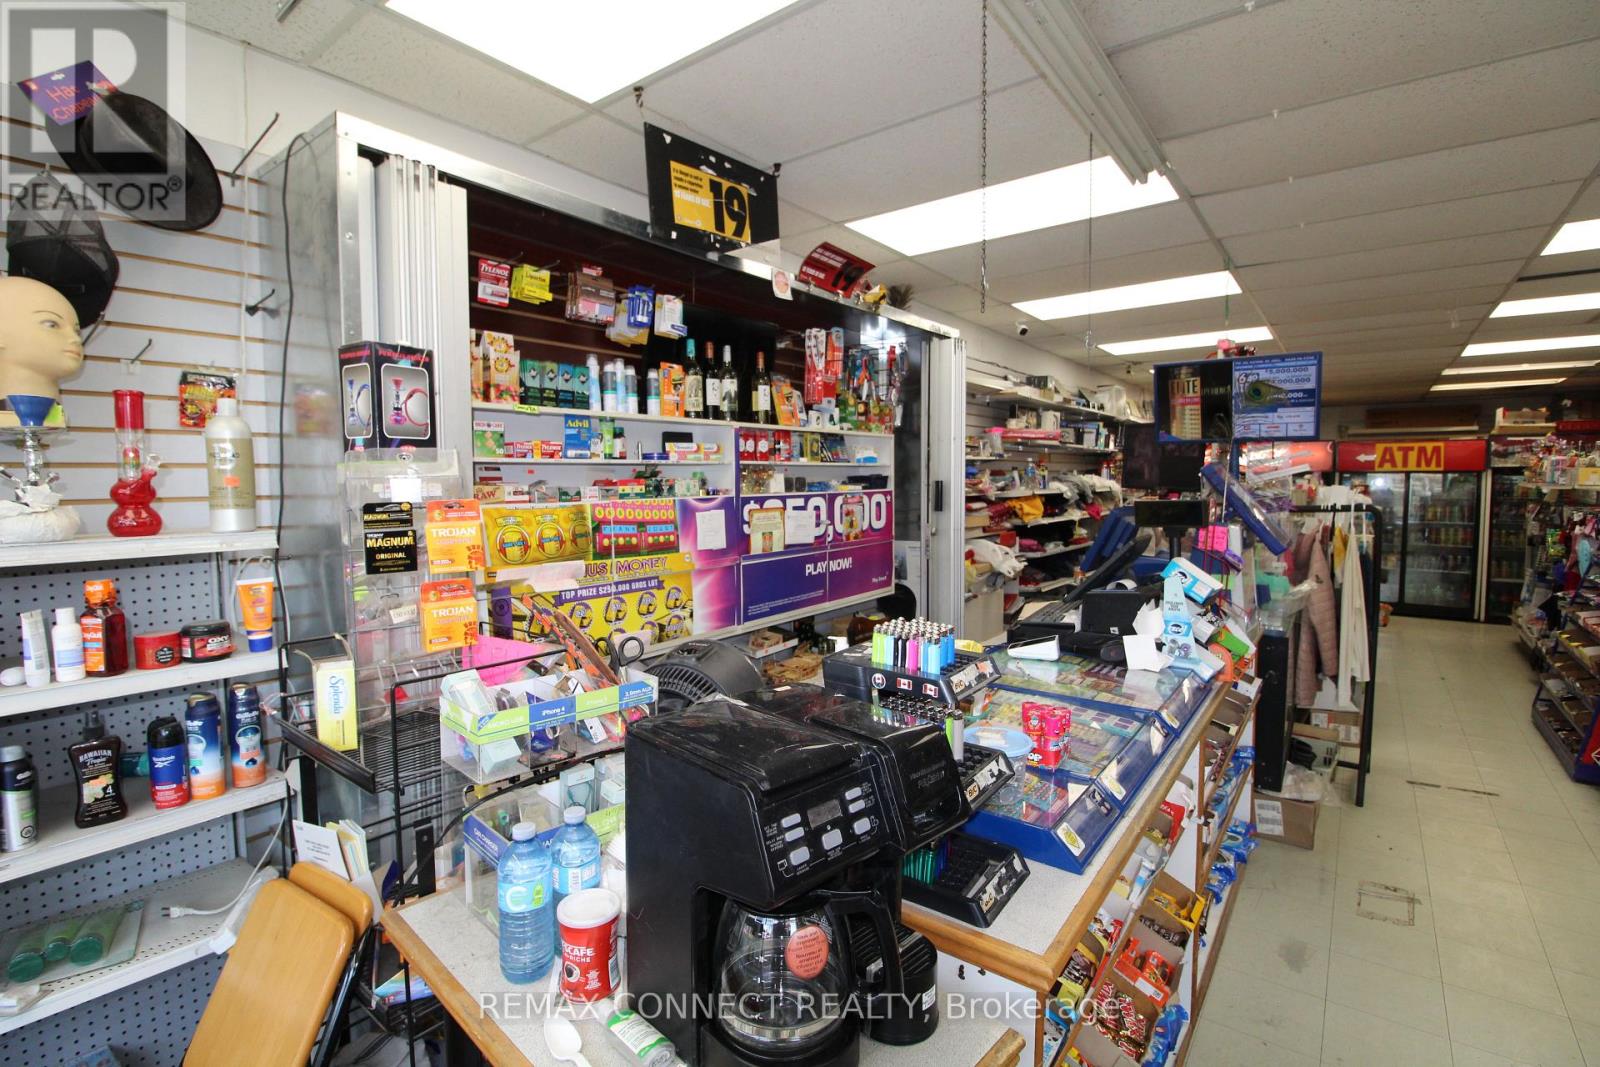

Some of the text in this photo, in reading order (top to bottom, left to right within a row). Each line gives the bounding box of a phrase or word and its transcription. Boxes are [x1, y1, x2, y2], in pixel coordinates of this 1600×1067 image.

[709, 178, 748, 239] 19
[566, 419, 589, 428] Advil
[1378, 445, 1443, 469] ATM
[432, 526, 477, 538] TROJAN
[366, 536, 414, 548] MAGNUM
[375, 552, 407, 560] ORIGINAL
[615, 556, 668, 574] MONEY
[805, 556, 853, 576] PLAY NOW!
[561, 590, 576, 600] TOP
[577, 588, 597, 598] PRIZE
[648, 579, 658, 588] LOT
[432, 606, 475, 618] TROJAN
[207, 635, 230, 644] OXY
[329, 675, 344, 715] Splenda
[79, 749, 112, 763] HAWAIIAN
[106, 785, 113, 794] 4
